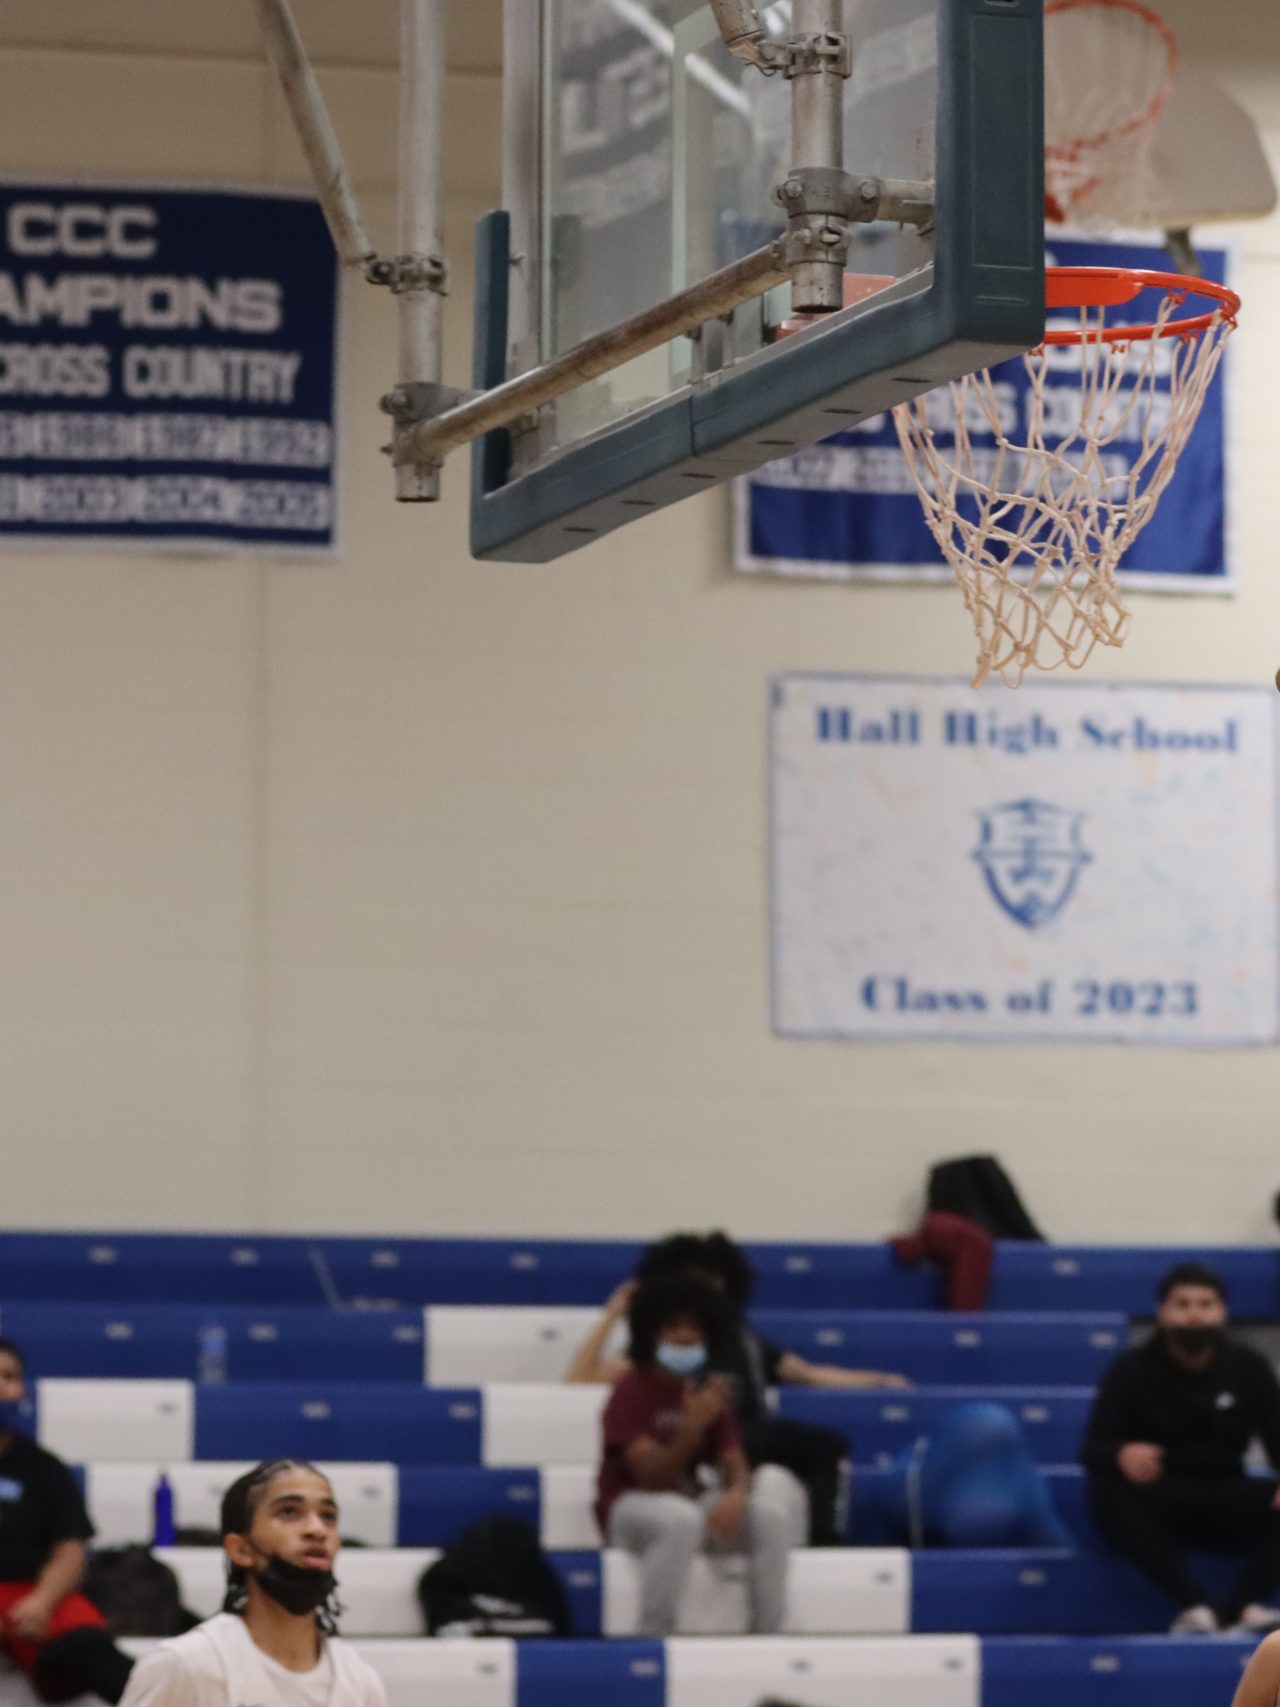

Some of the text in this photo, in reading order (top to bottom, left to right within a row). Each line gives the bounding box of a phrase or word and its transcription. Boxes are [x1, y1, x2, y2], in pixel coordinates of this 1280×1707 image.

[8, 203, 158, 259] CCC
[122, 345, 301, 404] COUNTRY
[816, 705, 1240, 755] Hall High School
[860, 974, 1200, 1018] Class of 2023
